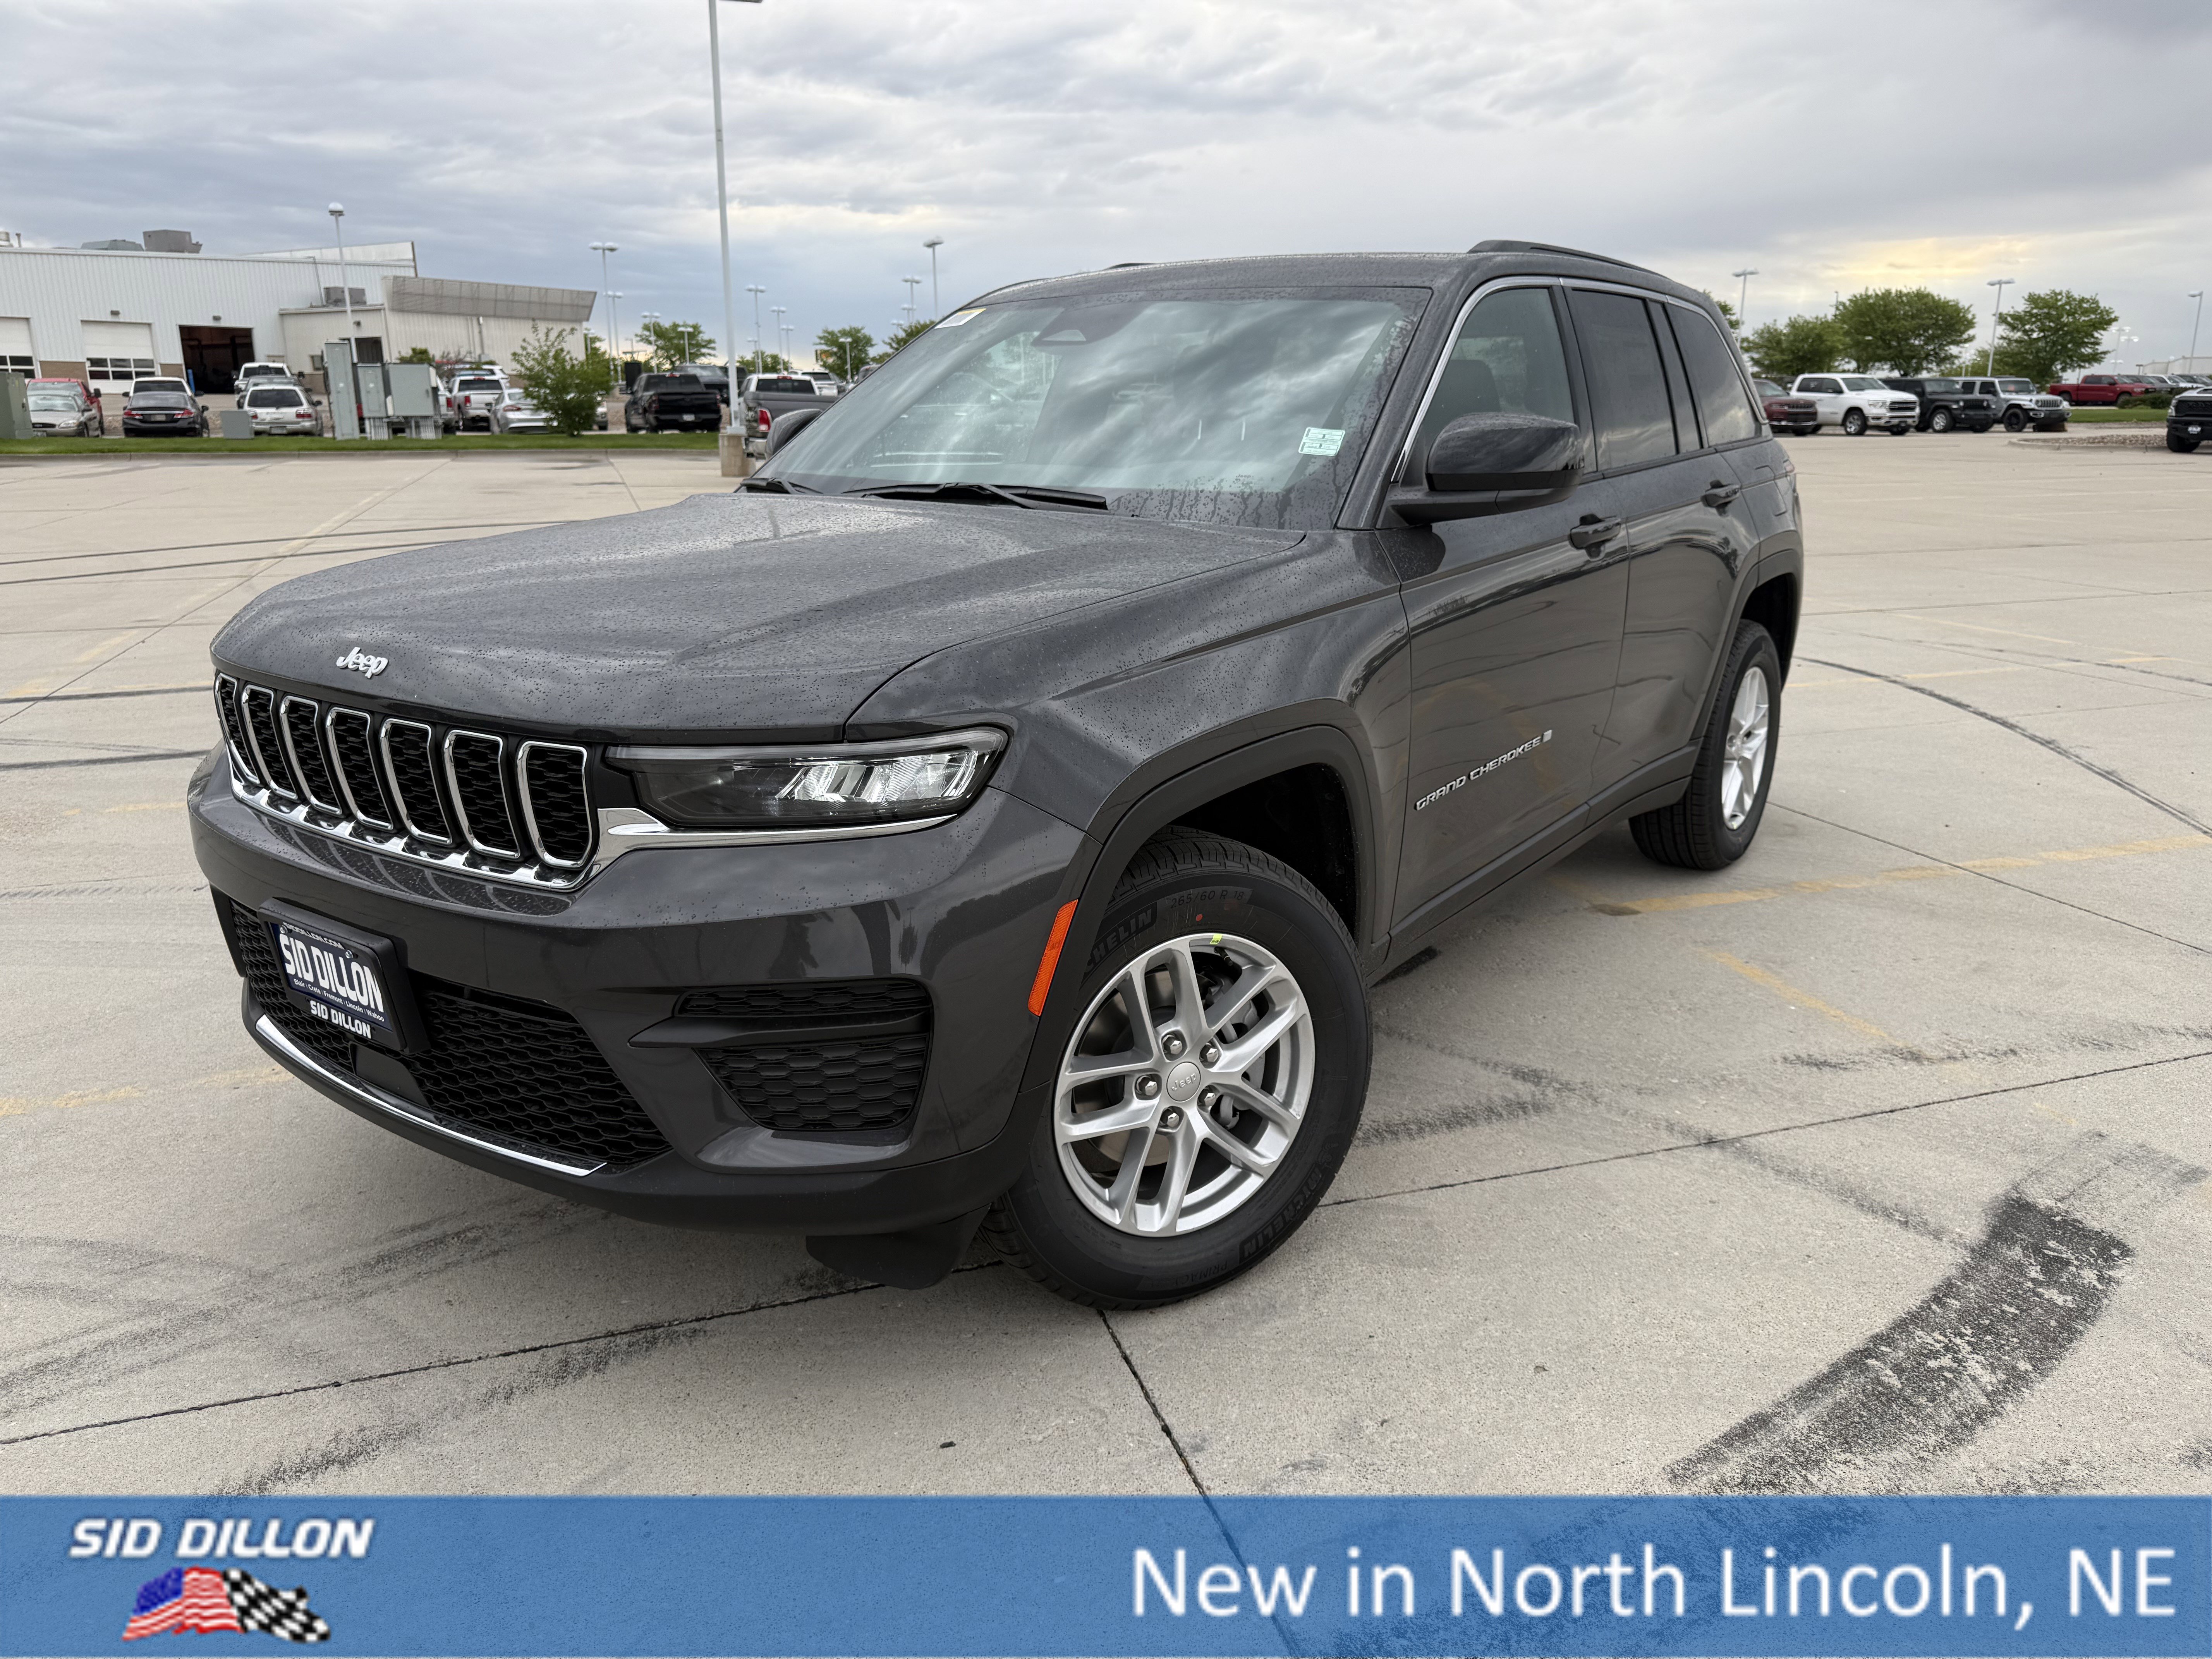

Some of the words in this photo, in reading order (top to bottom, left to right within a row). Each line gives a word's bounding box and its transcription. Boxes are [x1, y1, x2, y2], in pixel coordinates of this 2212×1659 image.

[336, 647, 388, 679] Jeep
[1416, 776, 1467, 811] GRAND
[1470, 736, 1541, 780] CHEROKEE
[1170, 891, 1216, 909] 265/60
[1220, 890, 1228, 900] R
[1234, 891, 1245, 901] 18
[279, 933, 314, 983] SID
[311, 946, 384, 1013] DILLON
[294, 978, 305, 988] Blair
[308, 984, 321, 994] Crete
[323, 990, 343, 1005] Fremont
[345, 1000, 364, 1013] Lincoln
[365, 1009, 385, 1022] Wahoo
[310, 1000, 329, 1020] SID
[330, 1008, 372, 1039] DILLON
[1171, 1073, 1197, 1091] Jeep
